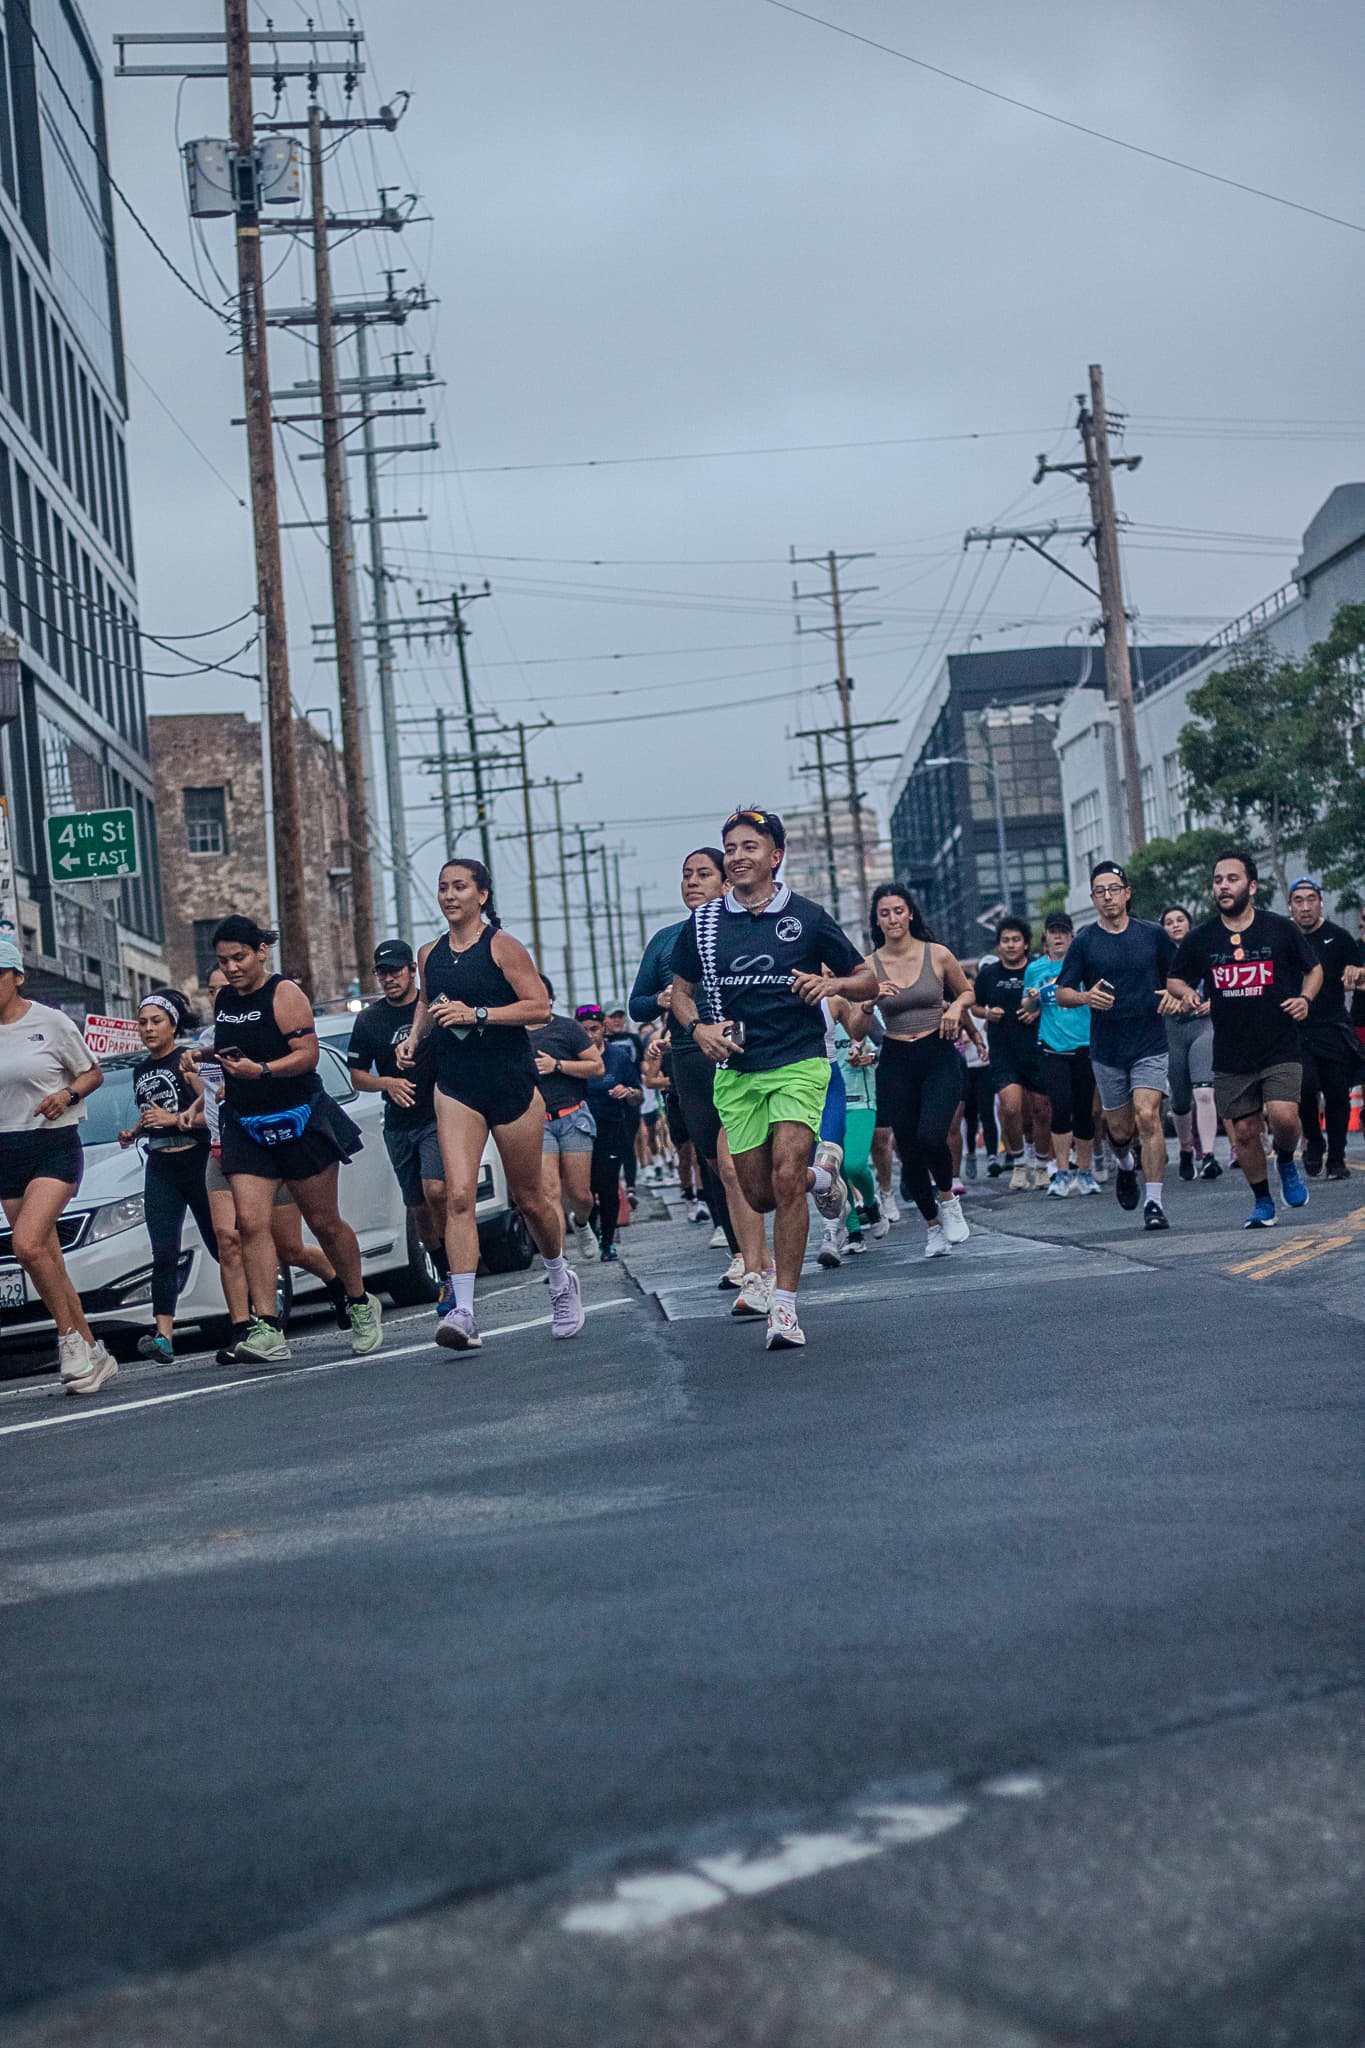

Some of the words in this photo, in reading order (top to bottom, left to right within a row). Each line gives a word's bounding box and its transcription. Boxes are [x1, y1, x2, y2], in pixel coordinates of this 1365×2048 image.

[58, 823, 94, 848] 4th
[102, 821, 126, 843] St
[87, 849, 127, 867] EAST
[1212, 963, 1273, 989] ドリフト
[1222, 988, 1244, 998] FORMULA
[1245, 986, 1263, 997] DRIFT
[95, 1018, 139, 1031] TOW-AWA
[96, 1027, 141, 1038] TEMPORAR
[87, 1034, 107, 1052] NO
